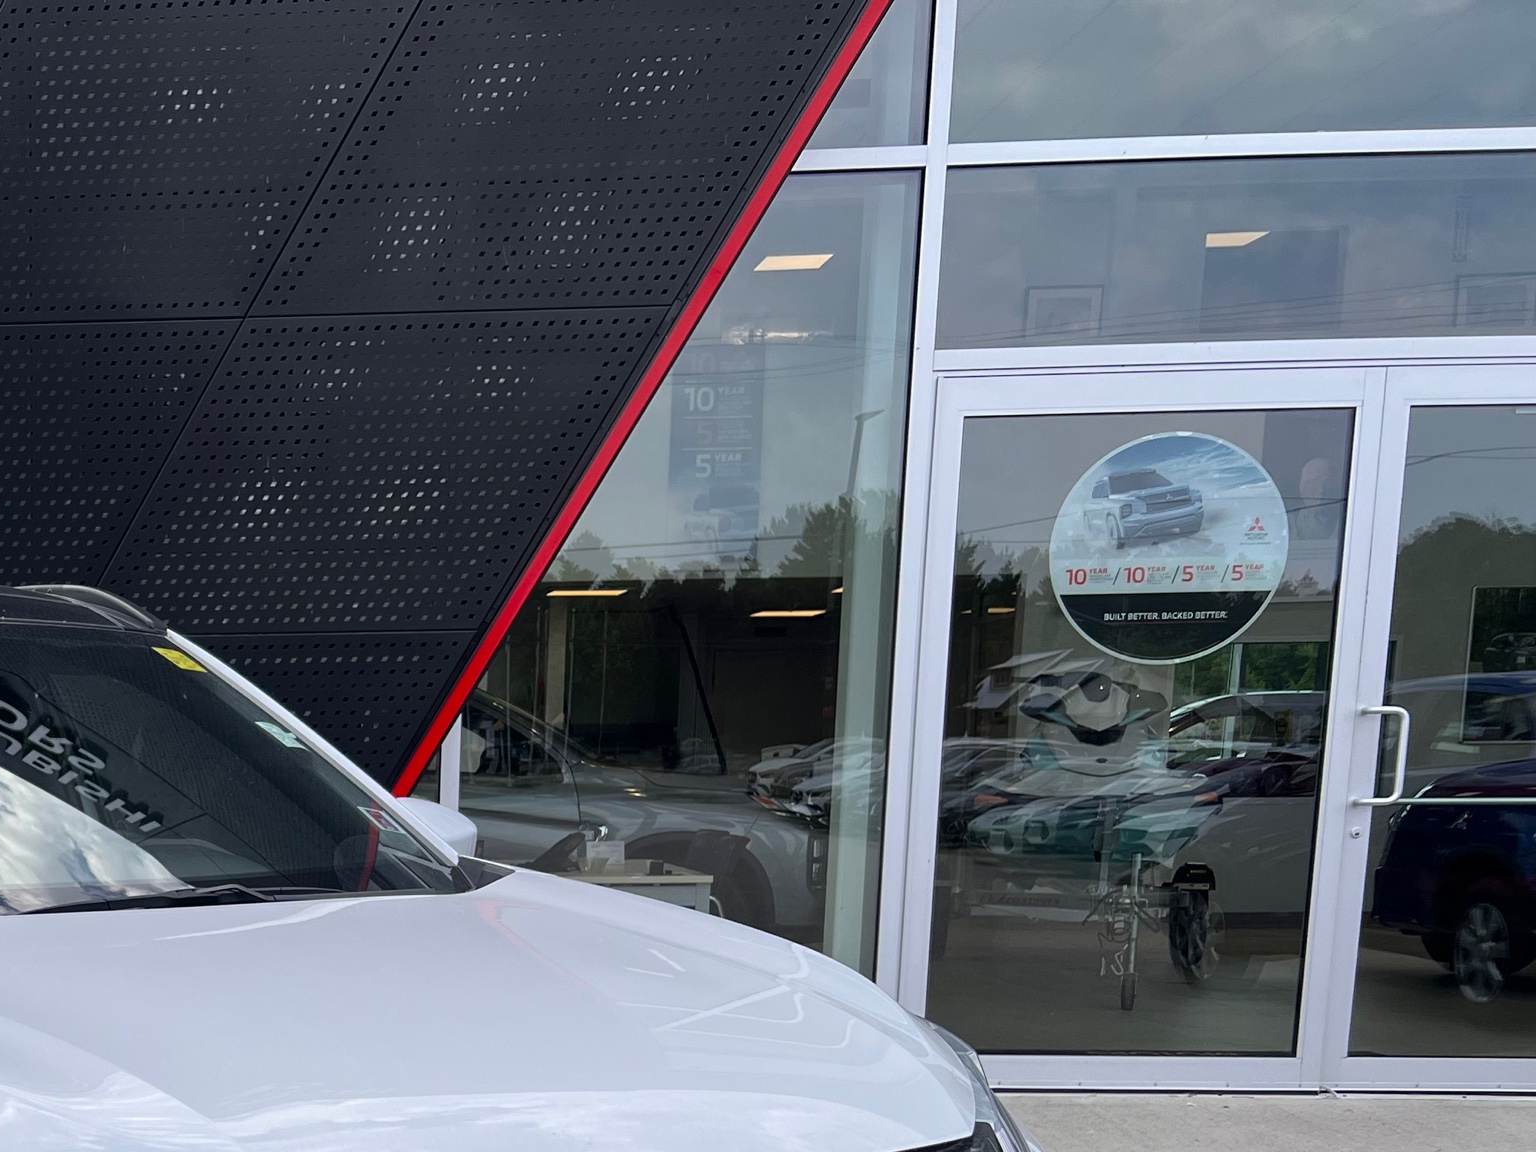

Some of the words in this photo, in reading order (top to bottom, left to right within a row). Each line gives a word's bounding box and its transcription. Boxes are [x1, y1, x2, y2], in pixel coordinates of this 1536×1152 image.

[685, 386, 715, 412] 10
[718, 386, 746, 395] YEAR
[695, 454, 712, 478] 5
[715, 453, 742, 462] YEAR
[1066, 568, 1087, 585] 10
[1124, 566, 1145, 583] 10
[1181, 565, 1194, 582] 5
[1231, 564, 1244, 581] 5
[1104, 613, 1126, 621] BUILT
[1161, 611, 1194, 619] BACKED
